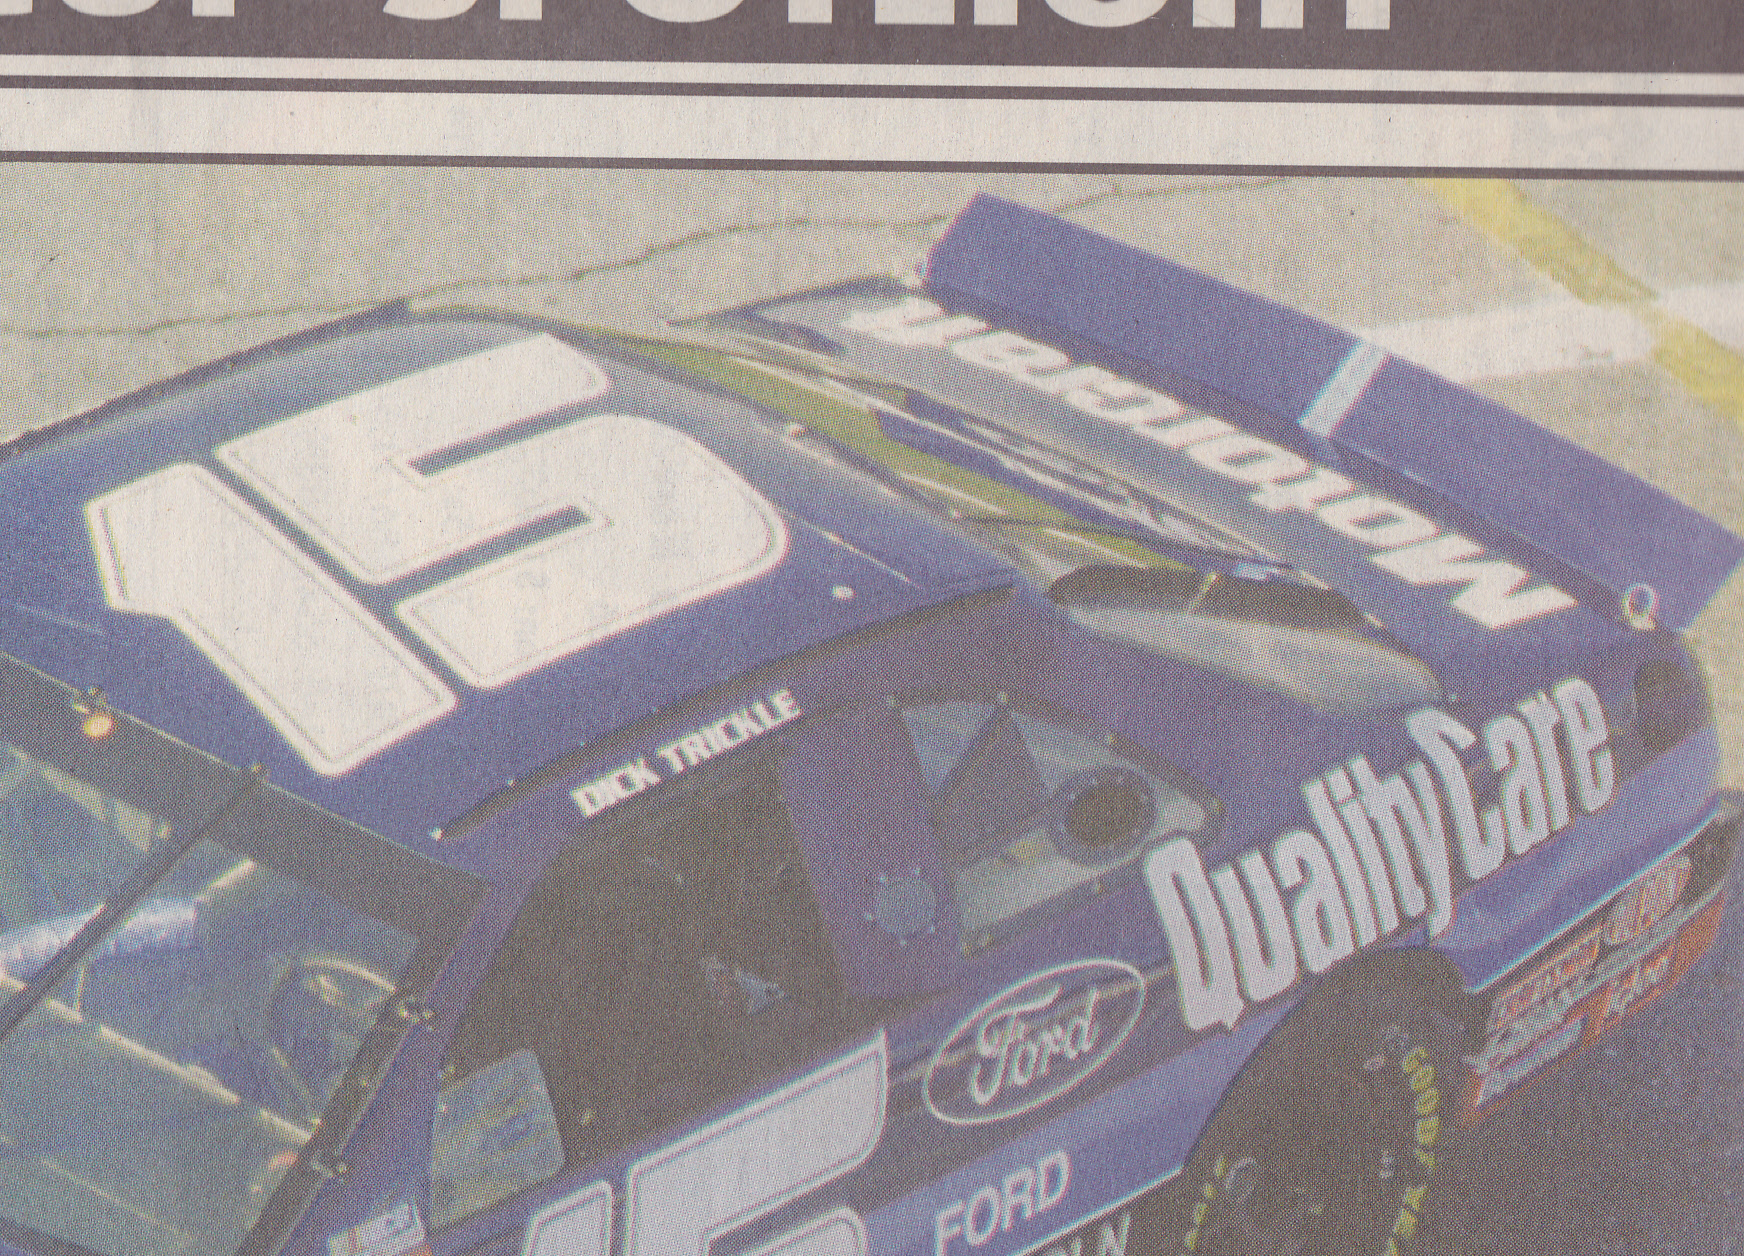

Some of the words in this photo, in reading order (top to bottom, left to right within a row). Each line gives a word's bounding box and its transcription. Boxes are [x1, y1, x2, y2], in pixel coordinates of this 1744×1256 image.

[84, 332, 790, 777] 15
[840, 296, 1578, 630] Motorcraft
[571, 757, 661, 819] DICK
[657, 689, 801, 777] TRICKLE
[971, 985, 1101, 1106] Ford
